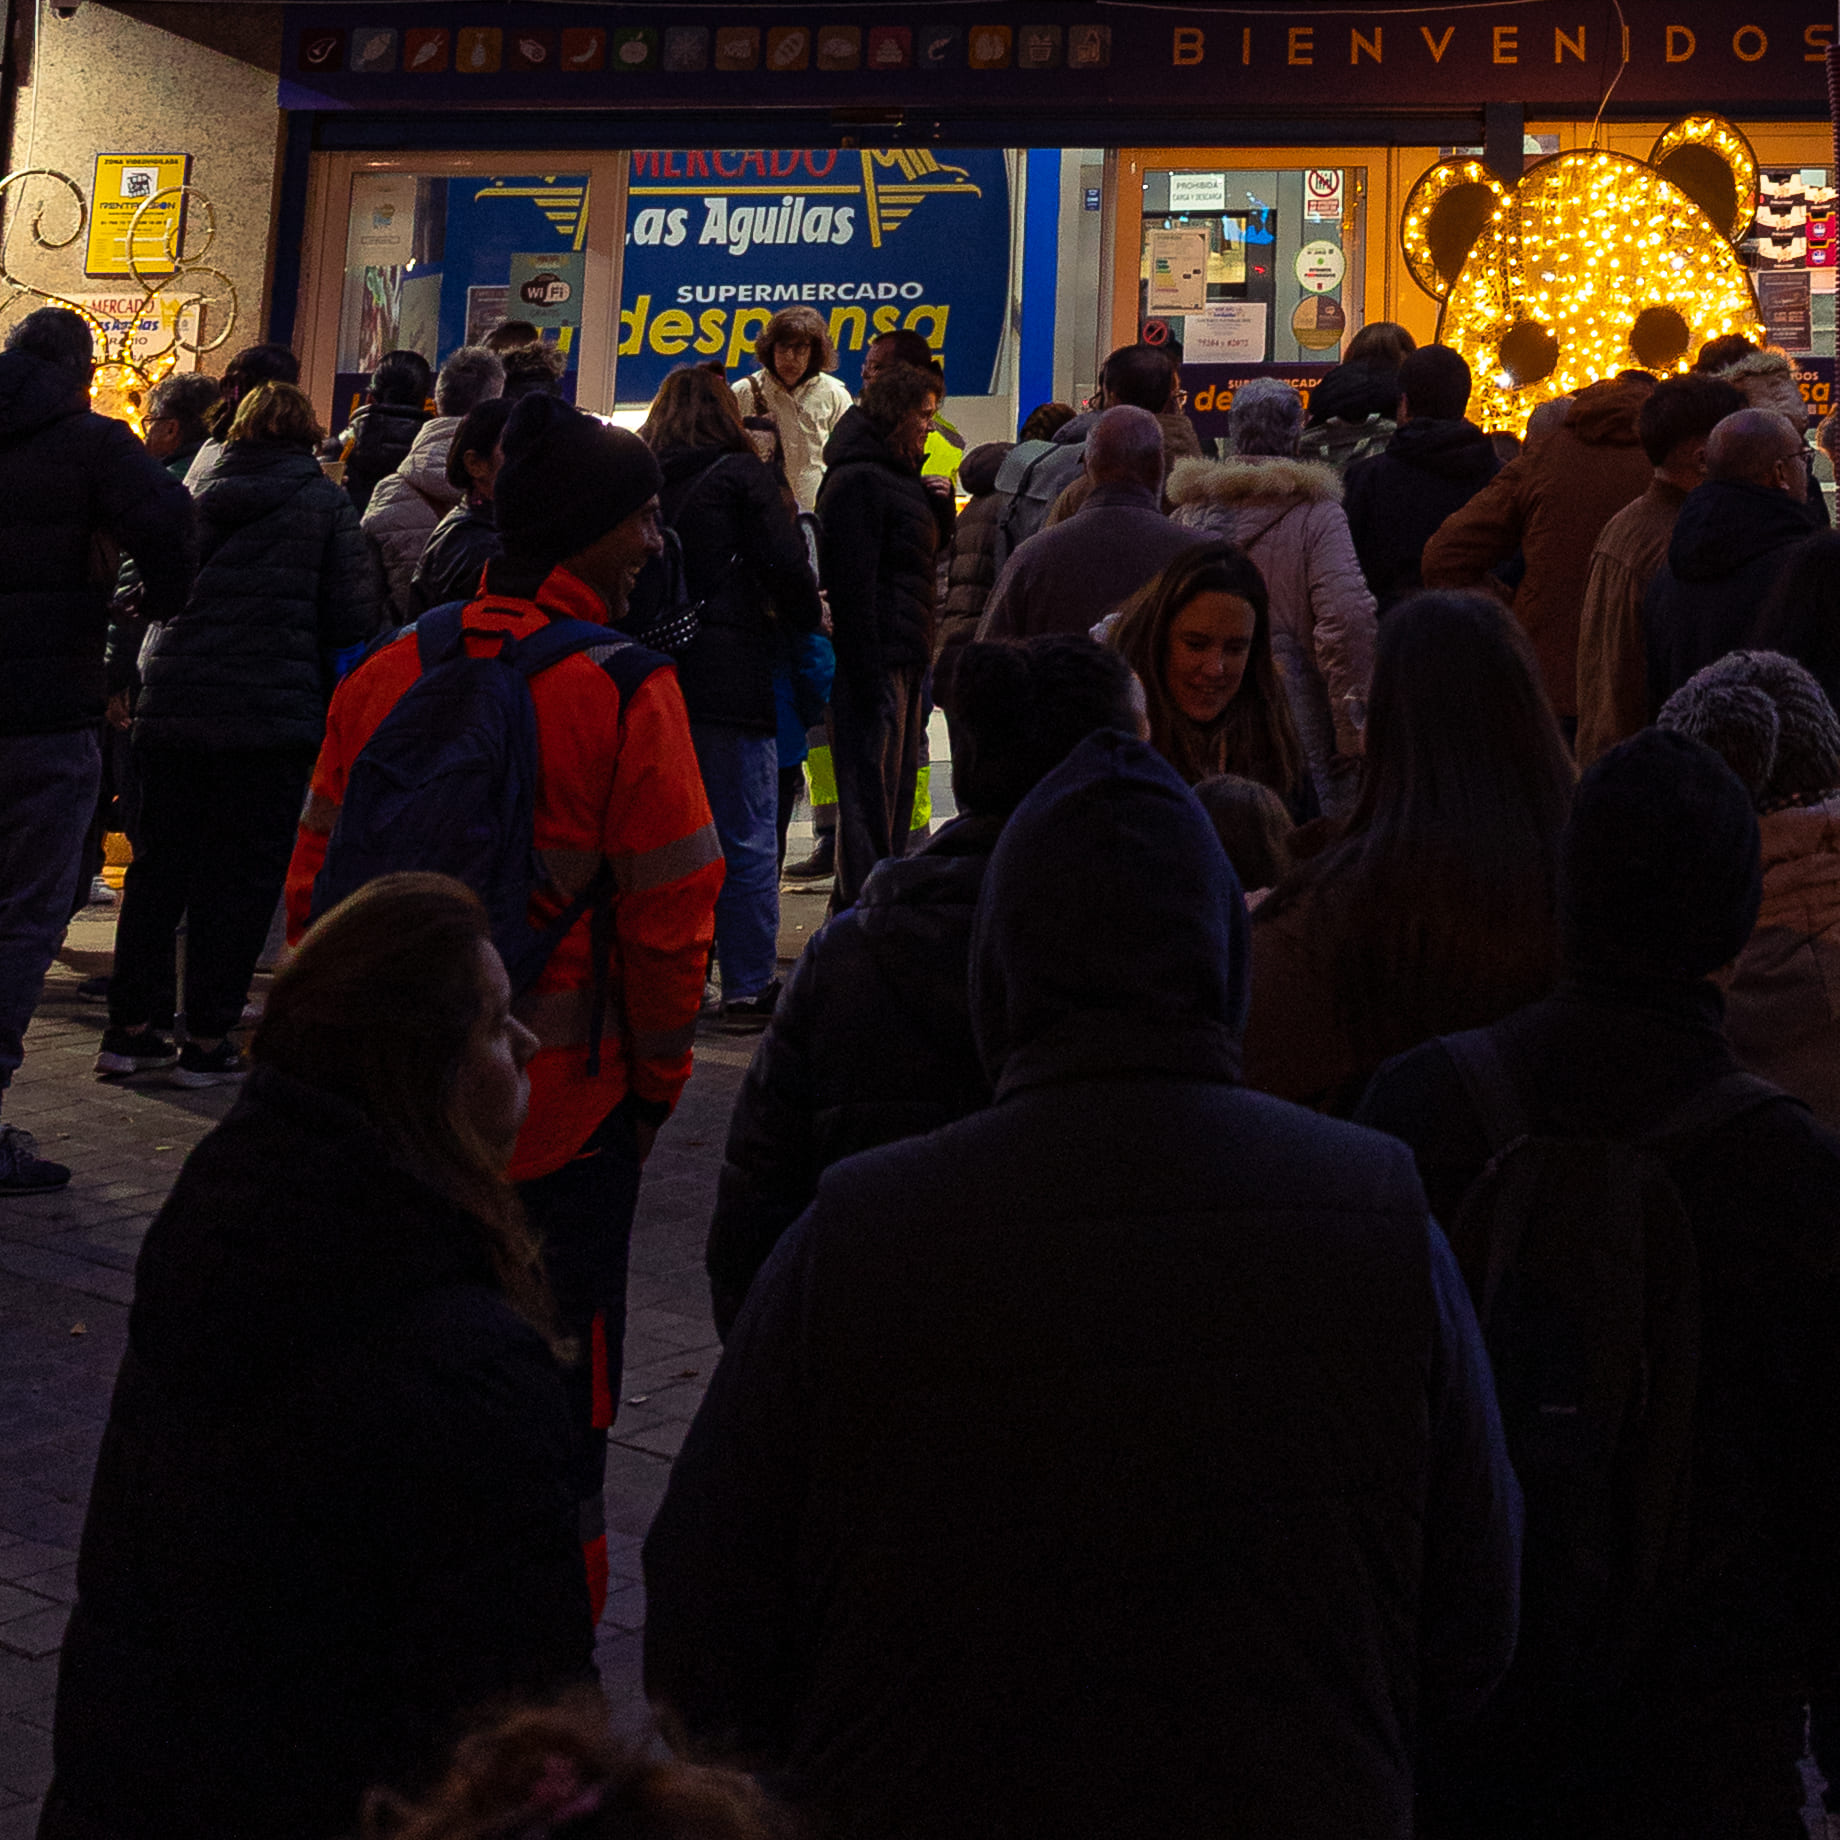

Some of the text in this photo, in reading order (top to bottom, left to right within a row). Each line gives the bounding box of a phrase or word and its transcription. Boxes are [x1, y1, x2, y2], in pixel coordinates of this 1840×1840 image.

[1172, 23, 1836, 66] BIENVENIDOS
[625, 196, 855, 256] as Aguilas
[676, 281, 924, 304] SUPERMERCADO
[617, 294, 950, 368] despnsa
